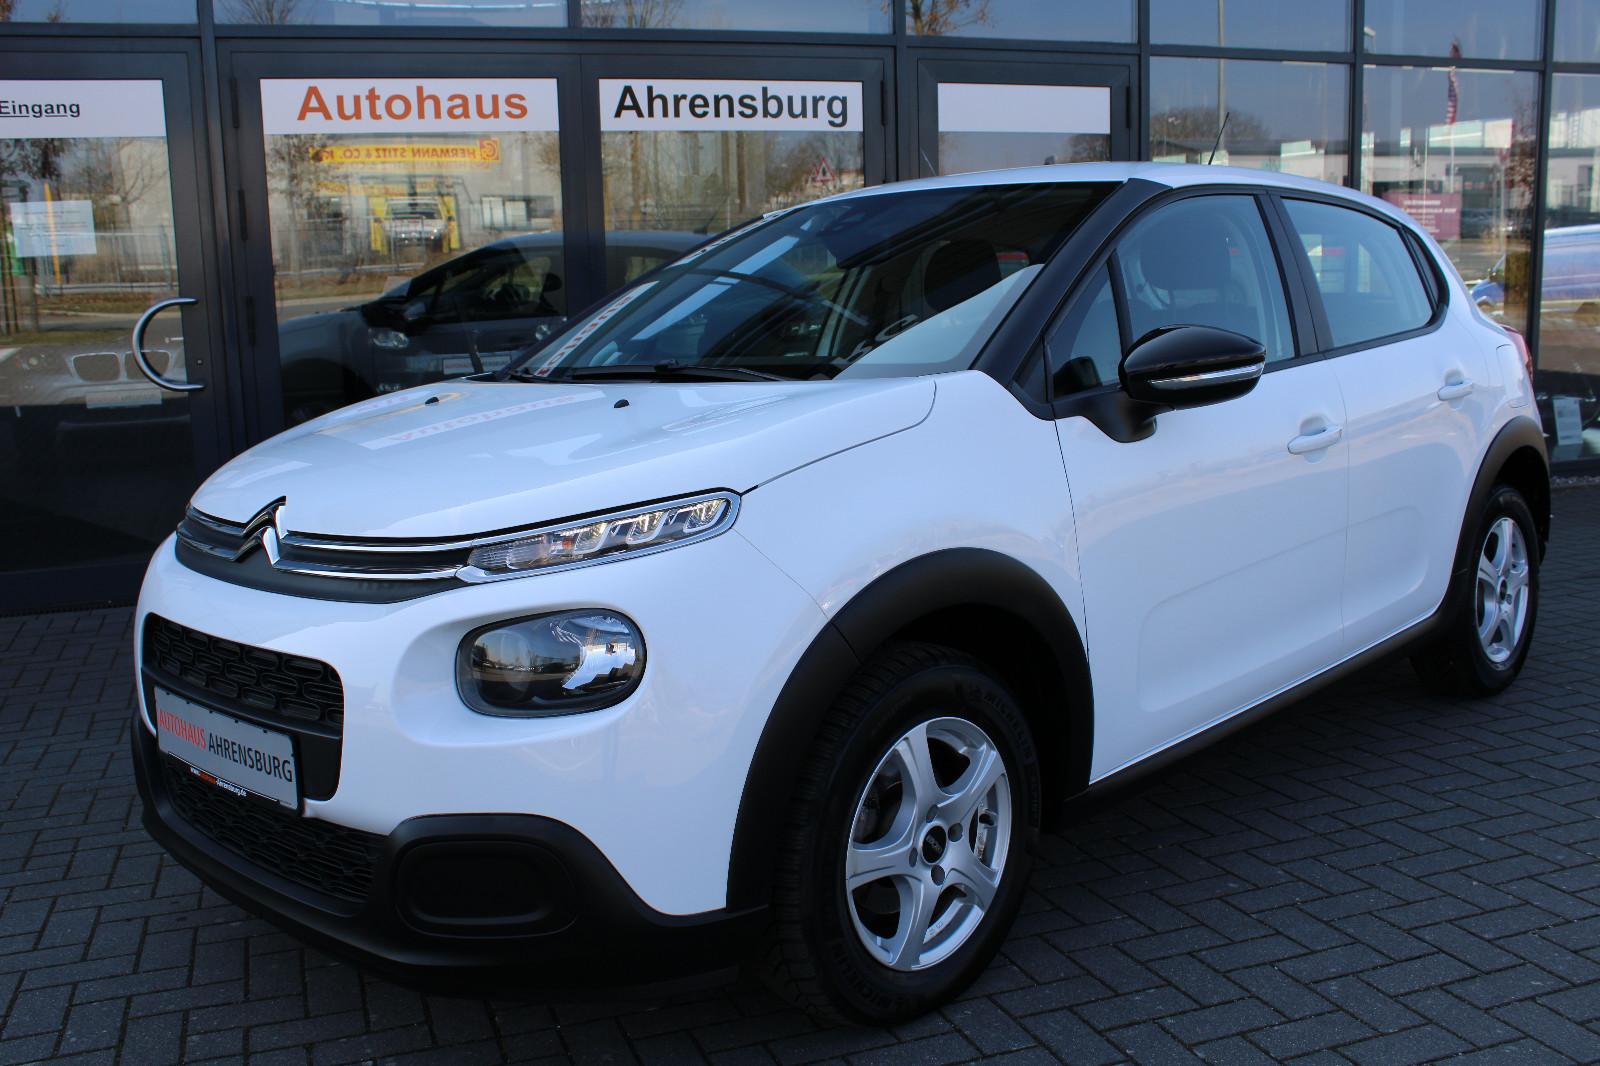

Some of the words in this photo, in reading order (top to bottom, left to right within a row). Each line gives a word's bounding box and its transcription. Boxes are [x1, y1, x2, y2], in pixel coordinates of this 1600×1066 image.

[0, 101, 80, 118] Eingang
[297, 86, 528, 121] Autohaus
[613, 85, 848, 128] Ahrensburg
[158, 709, 207, 750] AUTOHAUS
[208, 733, 293, 782] AHRENSBURG
